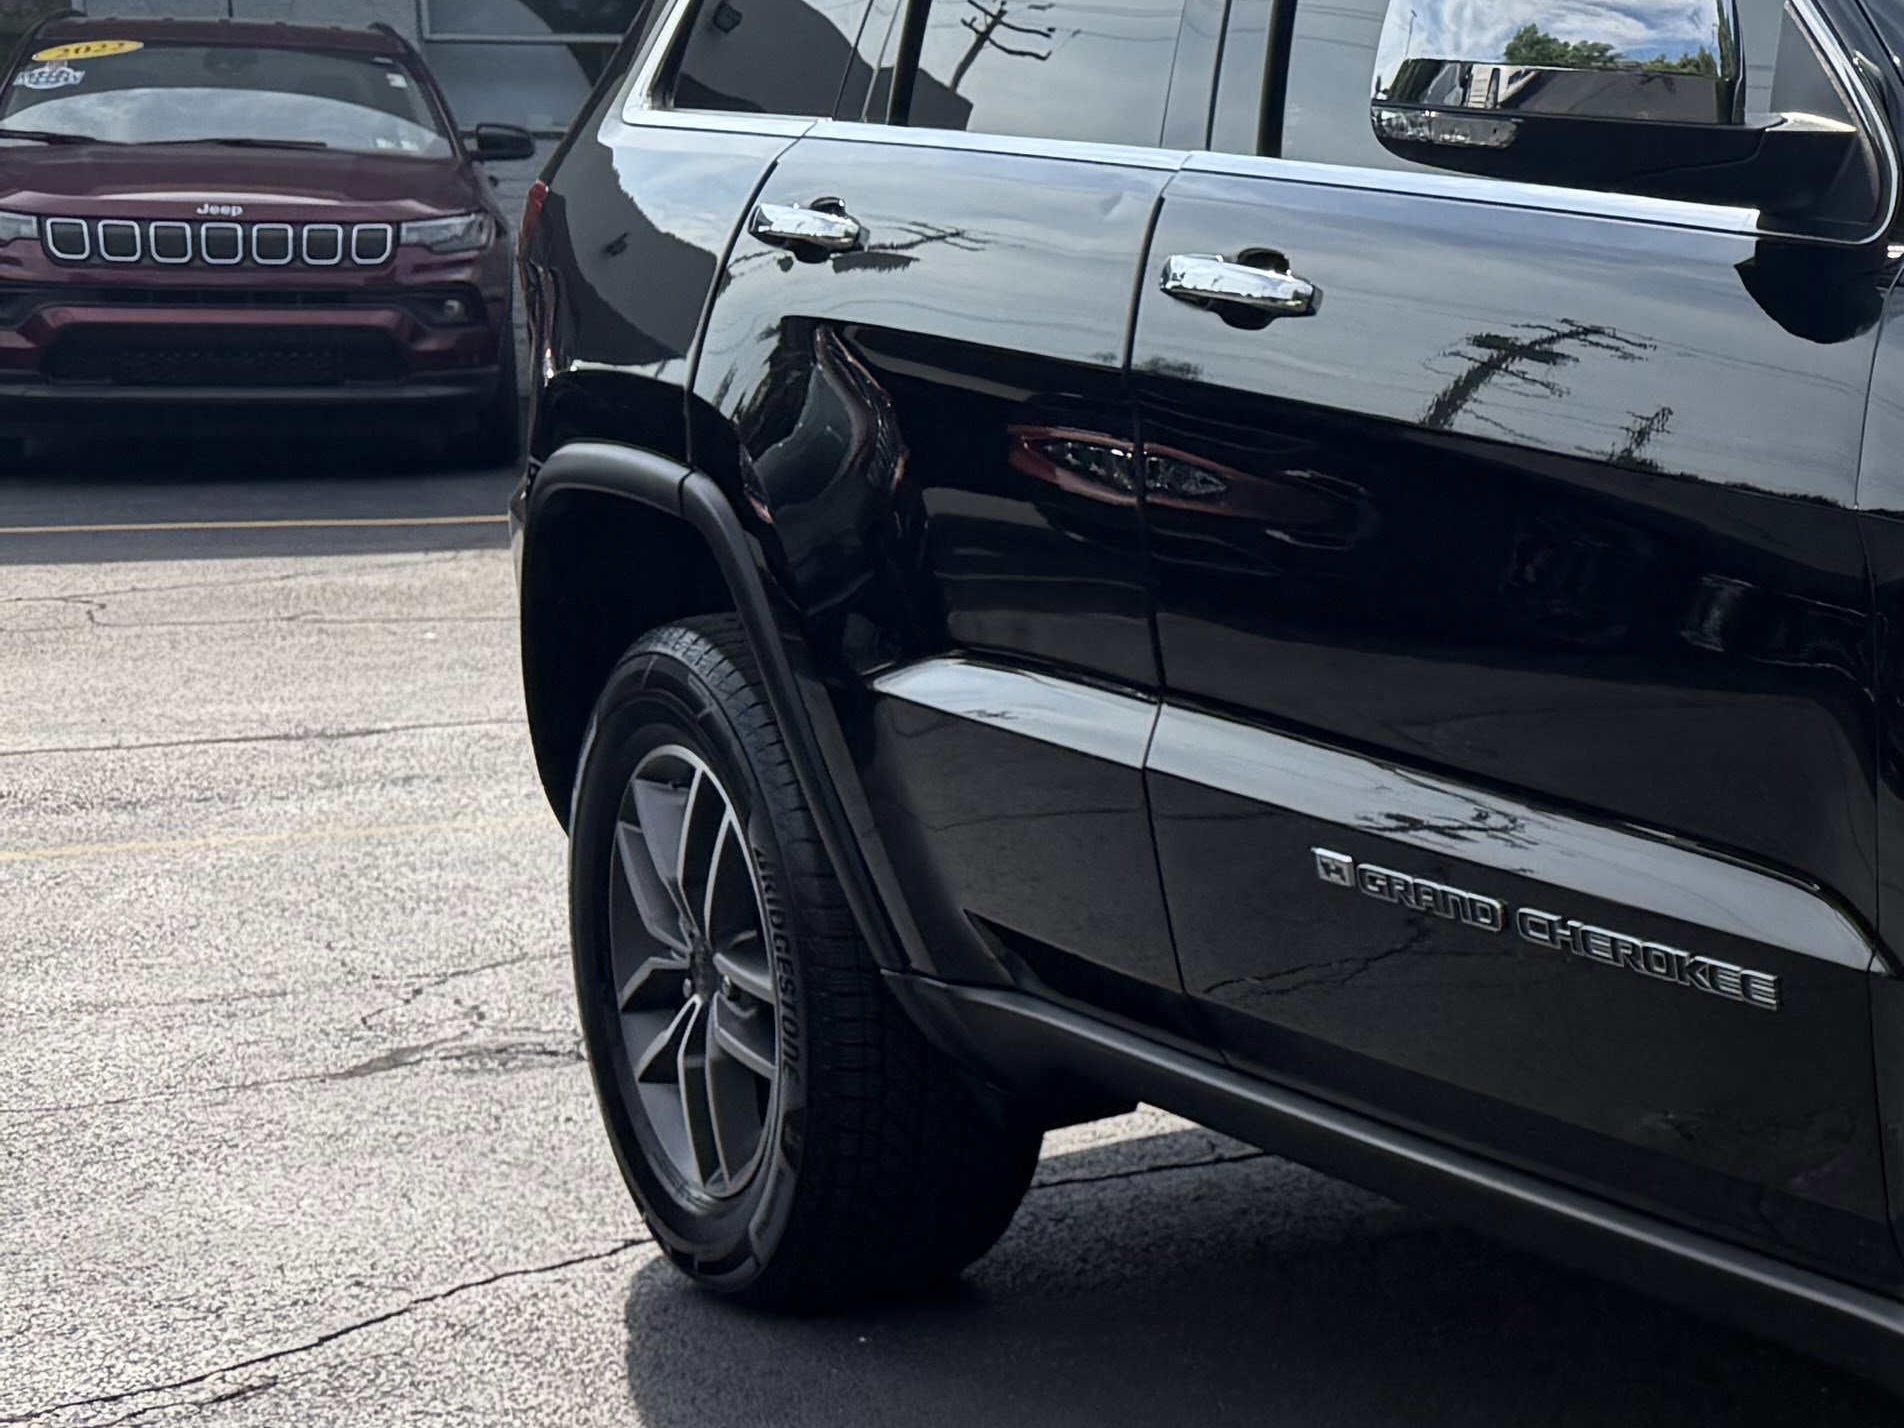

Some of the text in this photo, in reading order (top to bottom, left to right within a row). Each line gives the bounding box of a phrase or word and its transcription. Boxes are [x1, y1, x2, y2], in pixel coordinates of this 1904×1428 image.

[196, 203, 243, 217] Jeep
[1357, 863, 1781, 1012] GRAND CHEROKEE
